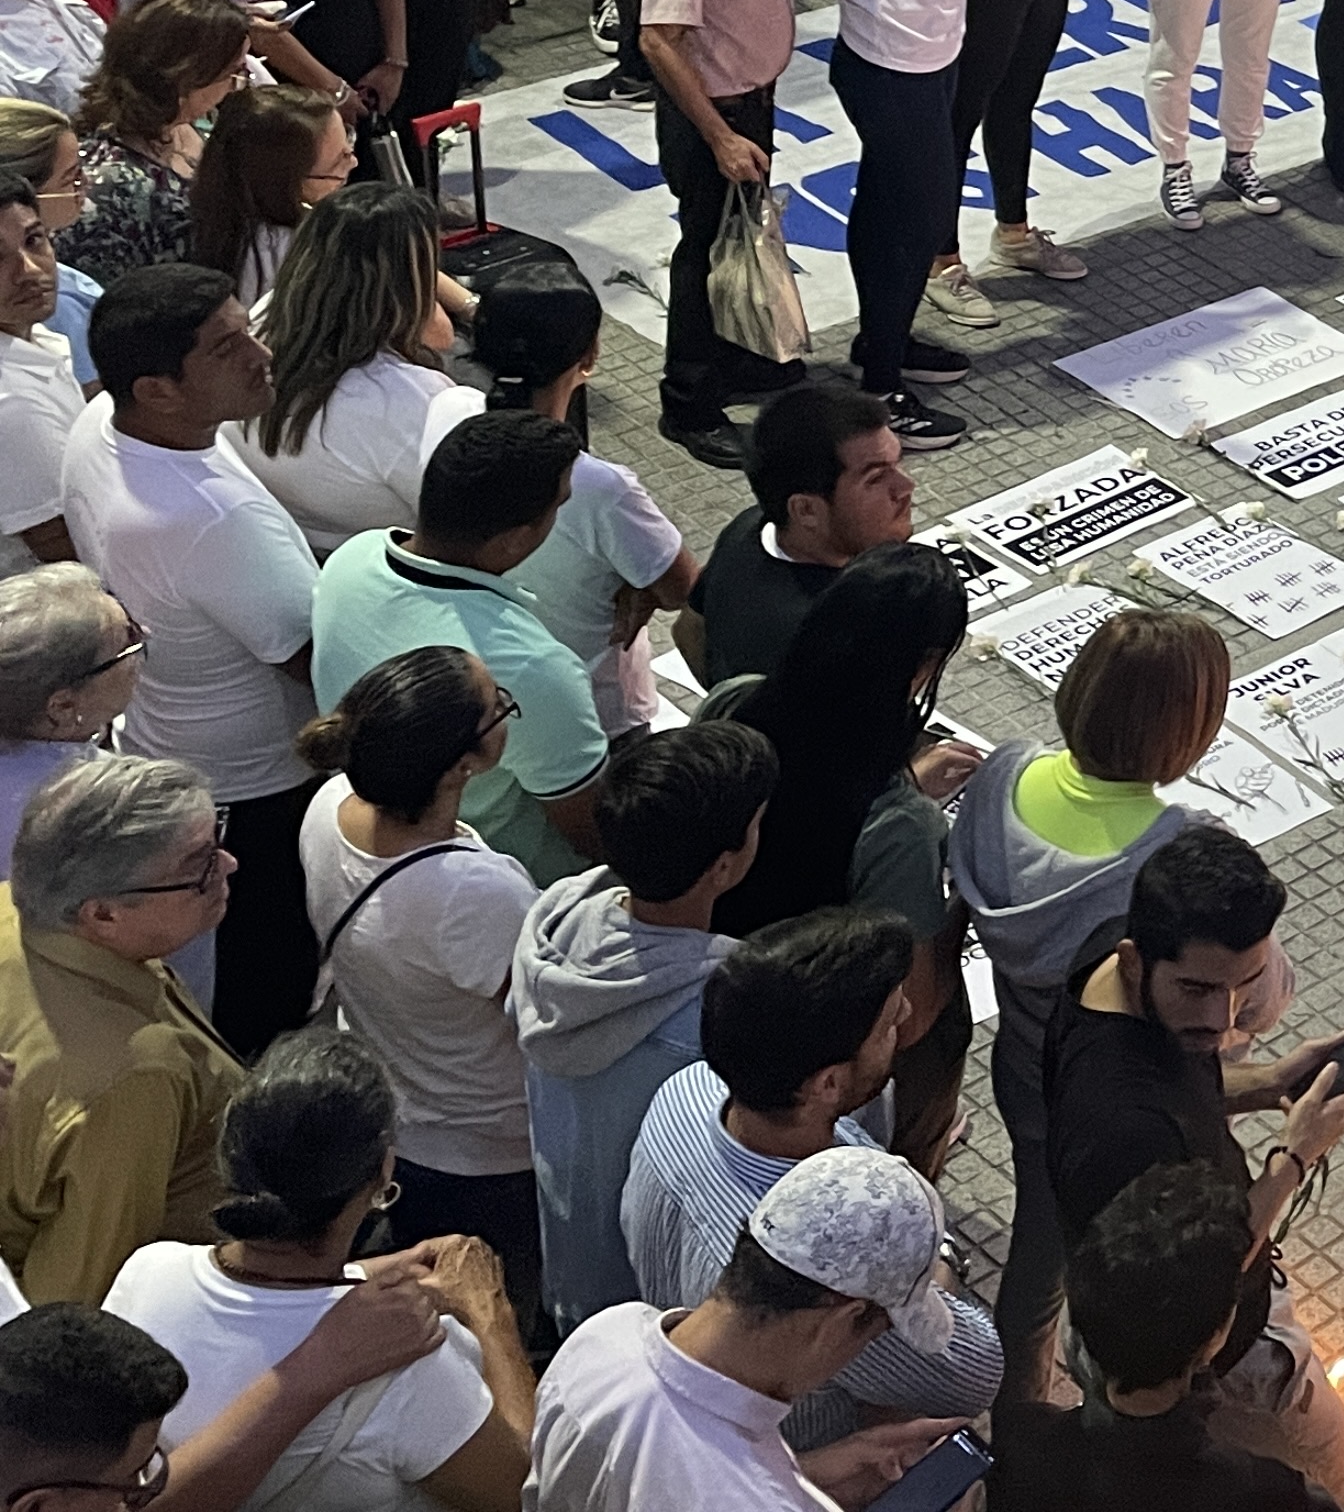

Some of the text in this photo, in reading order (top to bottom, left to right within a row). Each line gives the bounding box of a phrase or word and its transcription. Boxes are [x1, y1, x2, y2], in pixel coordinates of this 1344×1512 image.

[1254, 418, 1325, 452] BASTA
[1047, 523, 1073, 541] UN
[1071, 494, 1138, 529] CRIMEN
[1135, 484, 1164, 501] DE
[1074, 492, 1177, 544] HUMANIDAD
[1200, 539, 1294, 585] TORTURADO
[1226, 531, 1284, 562] SIENDO
[1000, 592, 1124, 652] DEFENDER
[1228, 656, 1313, 699] JUNIOR
[1253, 672, 1321, 703] SLVA
